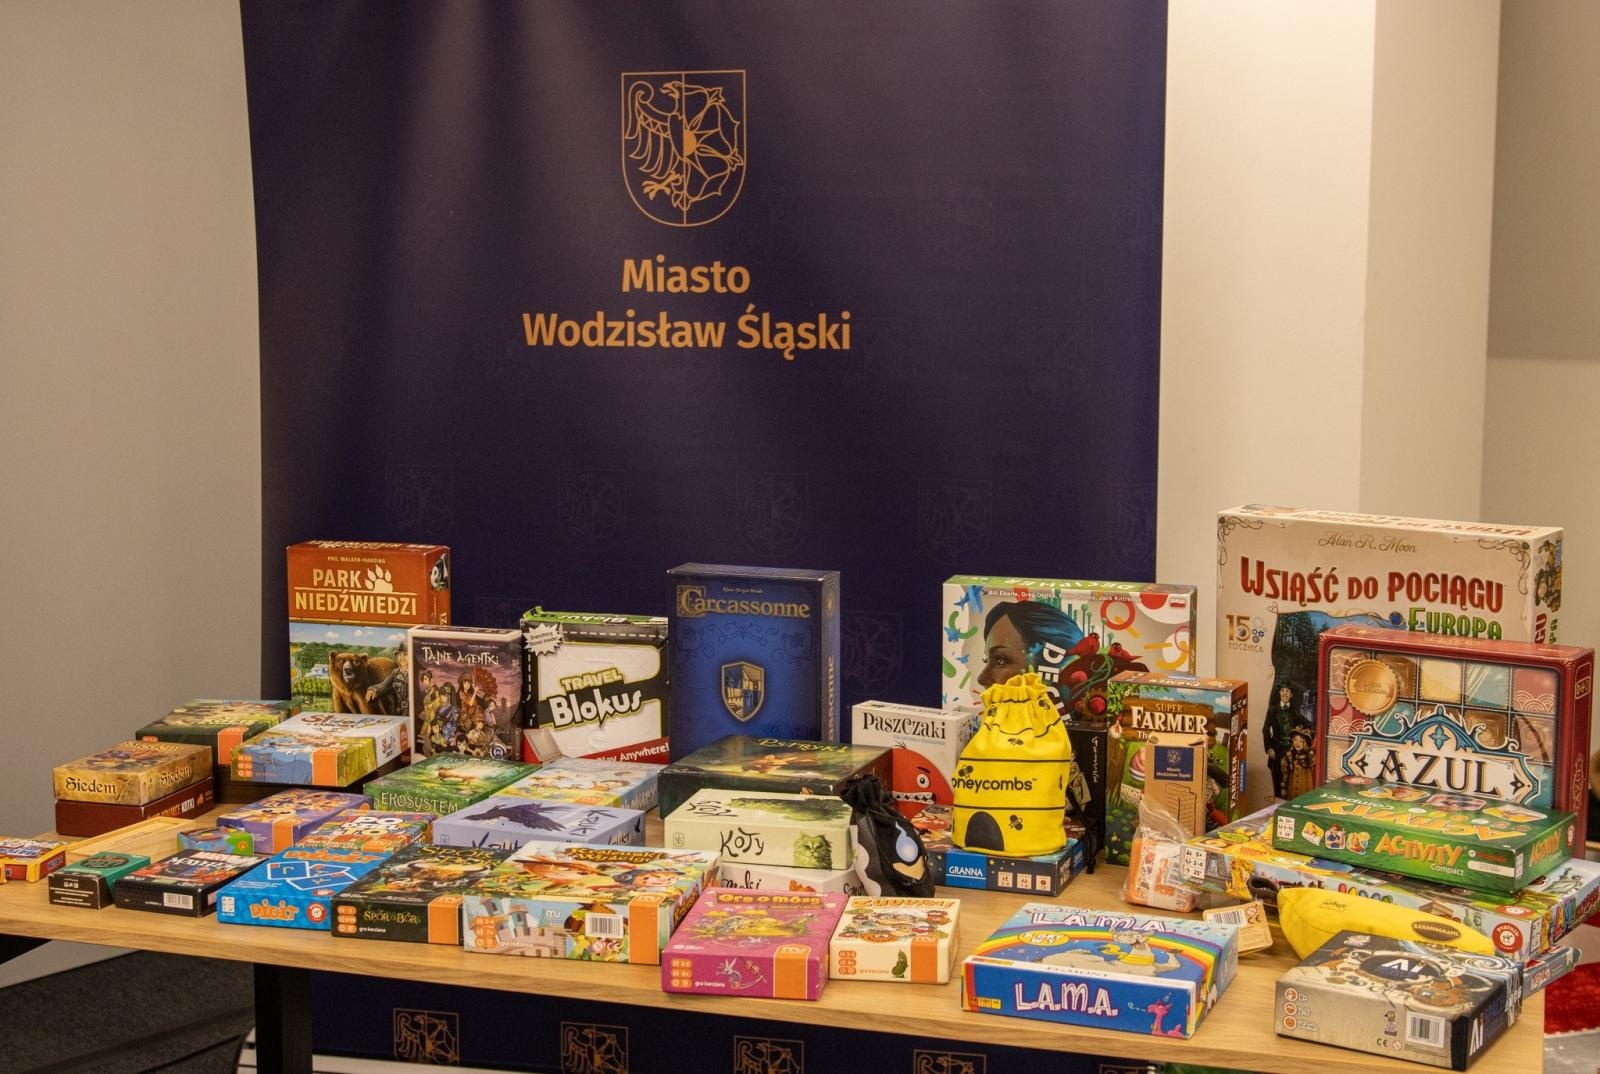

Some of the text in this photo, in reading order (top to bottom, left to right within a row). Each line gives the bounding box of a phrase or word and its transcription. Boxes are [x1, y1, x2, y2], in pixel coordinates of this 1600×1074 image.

[621, 254, 751, 294] Miasto
[522, 303, 851, 361] Wodzisław Śląski
[1318, 531, 1353, 549] Alan
[1379, 535, 1417, 553] Moon
[312, 568, 362, 589] PARK
[1241, 556, 1505, 613] WSIĄŚĆ DO POCIĄGU
[295, 588, 417, 616] NIEDŹWIEDZI
[680, 588, 811, 618] Carcassonne
[1226, 614, 1250, 642] 15
[1408, 607, 1503, 641] EUROPA
[561, 668, 624, 691] TRAVEL
[548, 688, 642, 728] Blokus
[1130, 705, 1208, 734] FARMER
[1155, 703, 1183, 713] SUPER
[863, 712, 946, 740] Paszczaki
[620, 742, 670, 760] Anywhere!
[65, 776, 117, 794] Siedem
[951, 775, 1033, 794] oneycombs
[1376, 749, 1502, 796] AZUL
[381, 791, 458, 814] EKOSYSTEM
[1375, 832, 1464, 866] ACTIVITY
[948, 866, 984, 877] GRANNA
[1430, 862, 1464, 877] Compact
[1413, 923, 1460, 938] BANANAGRAMS
